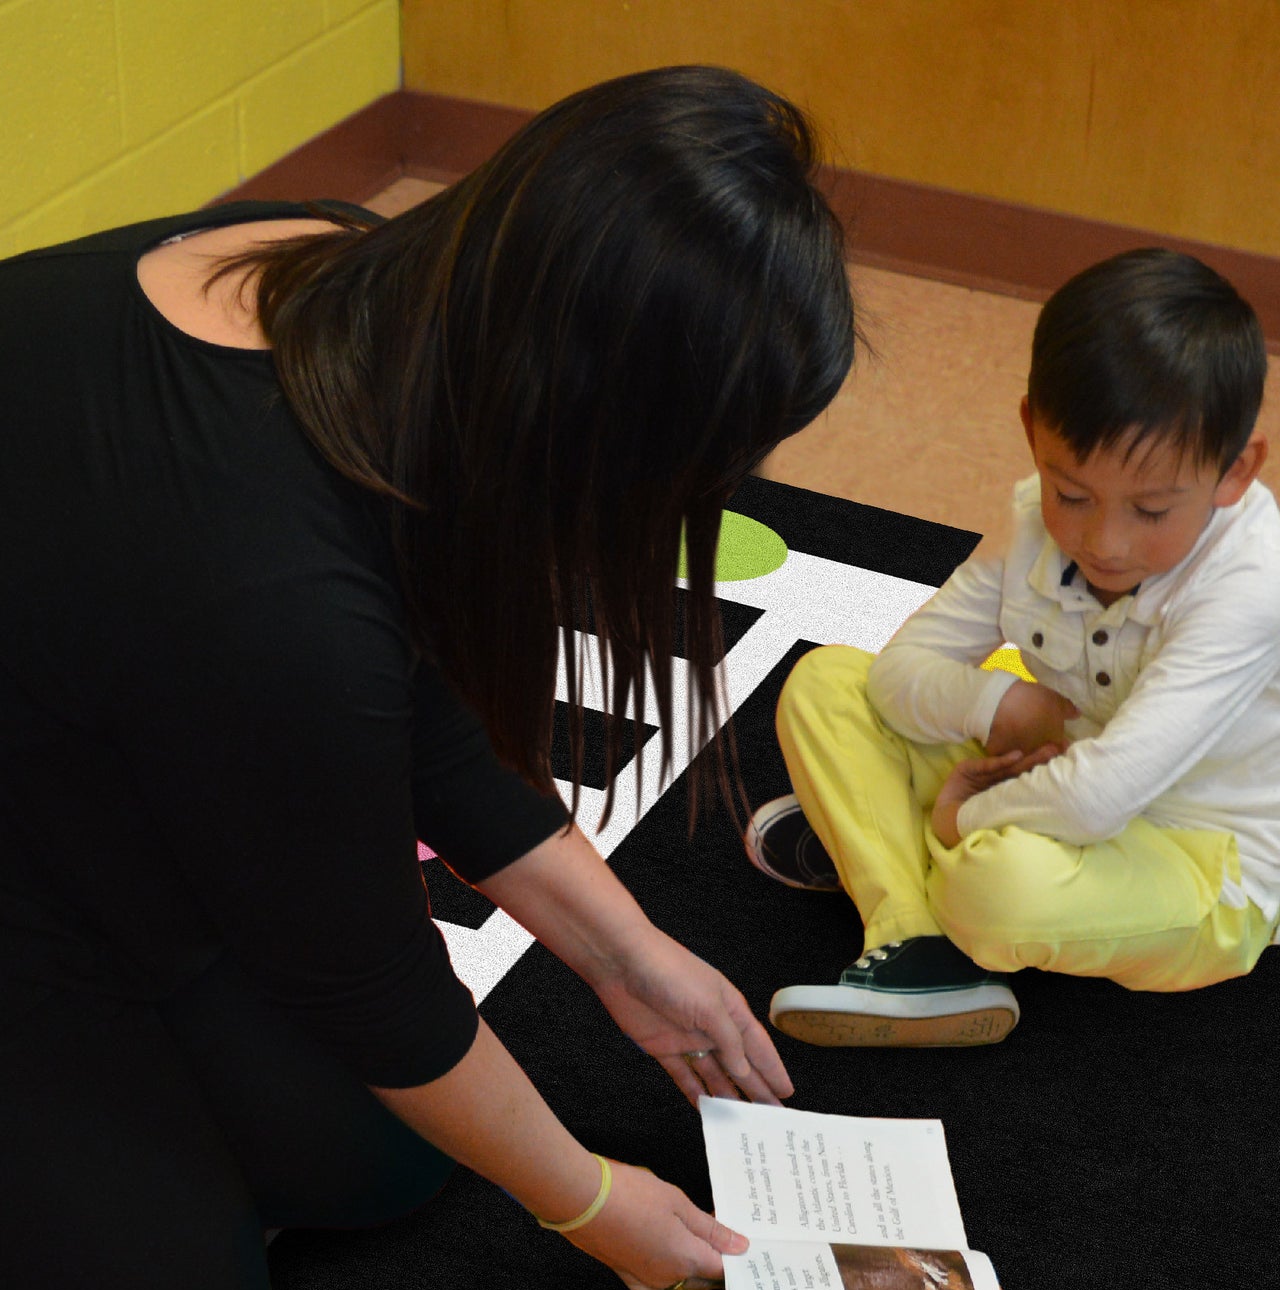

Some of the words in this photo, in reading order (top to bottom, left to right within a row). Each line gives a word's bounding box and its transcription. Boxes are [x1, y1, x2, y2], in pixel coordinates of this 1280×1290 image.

[835, 1163, 847, 1189] Florida
[752, 1204, 761, 1222] They
[828, 1206, 841, 1232] United
